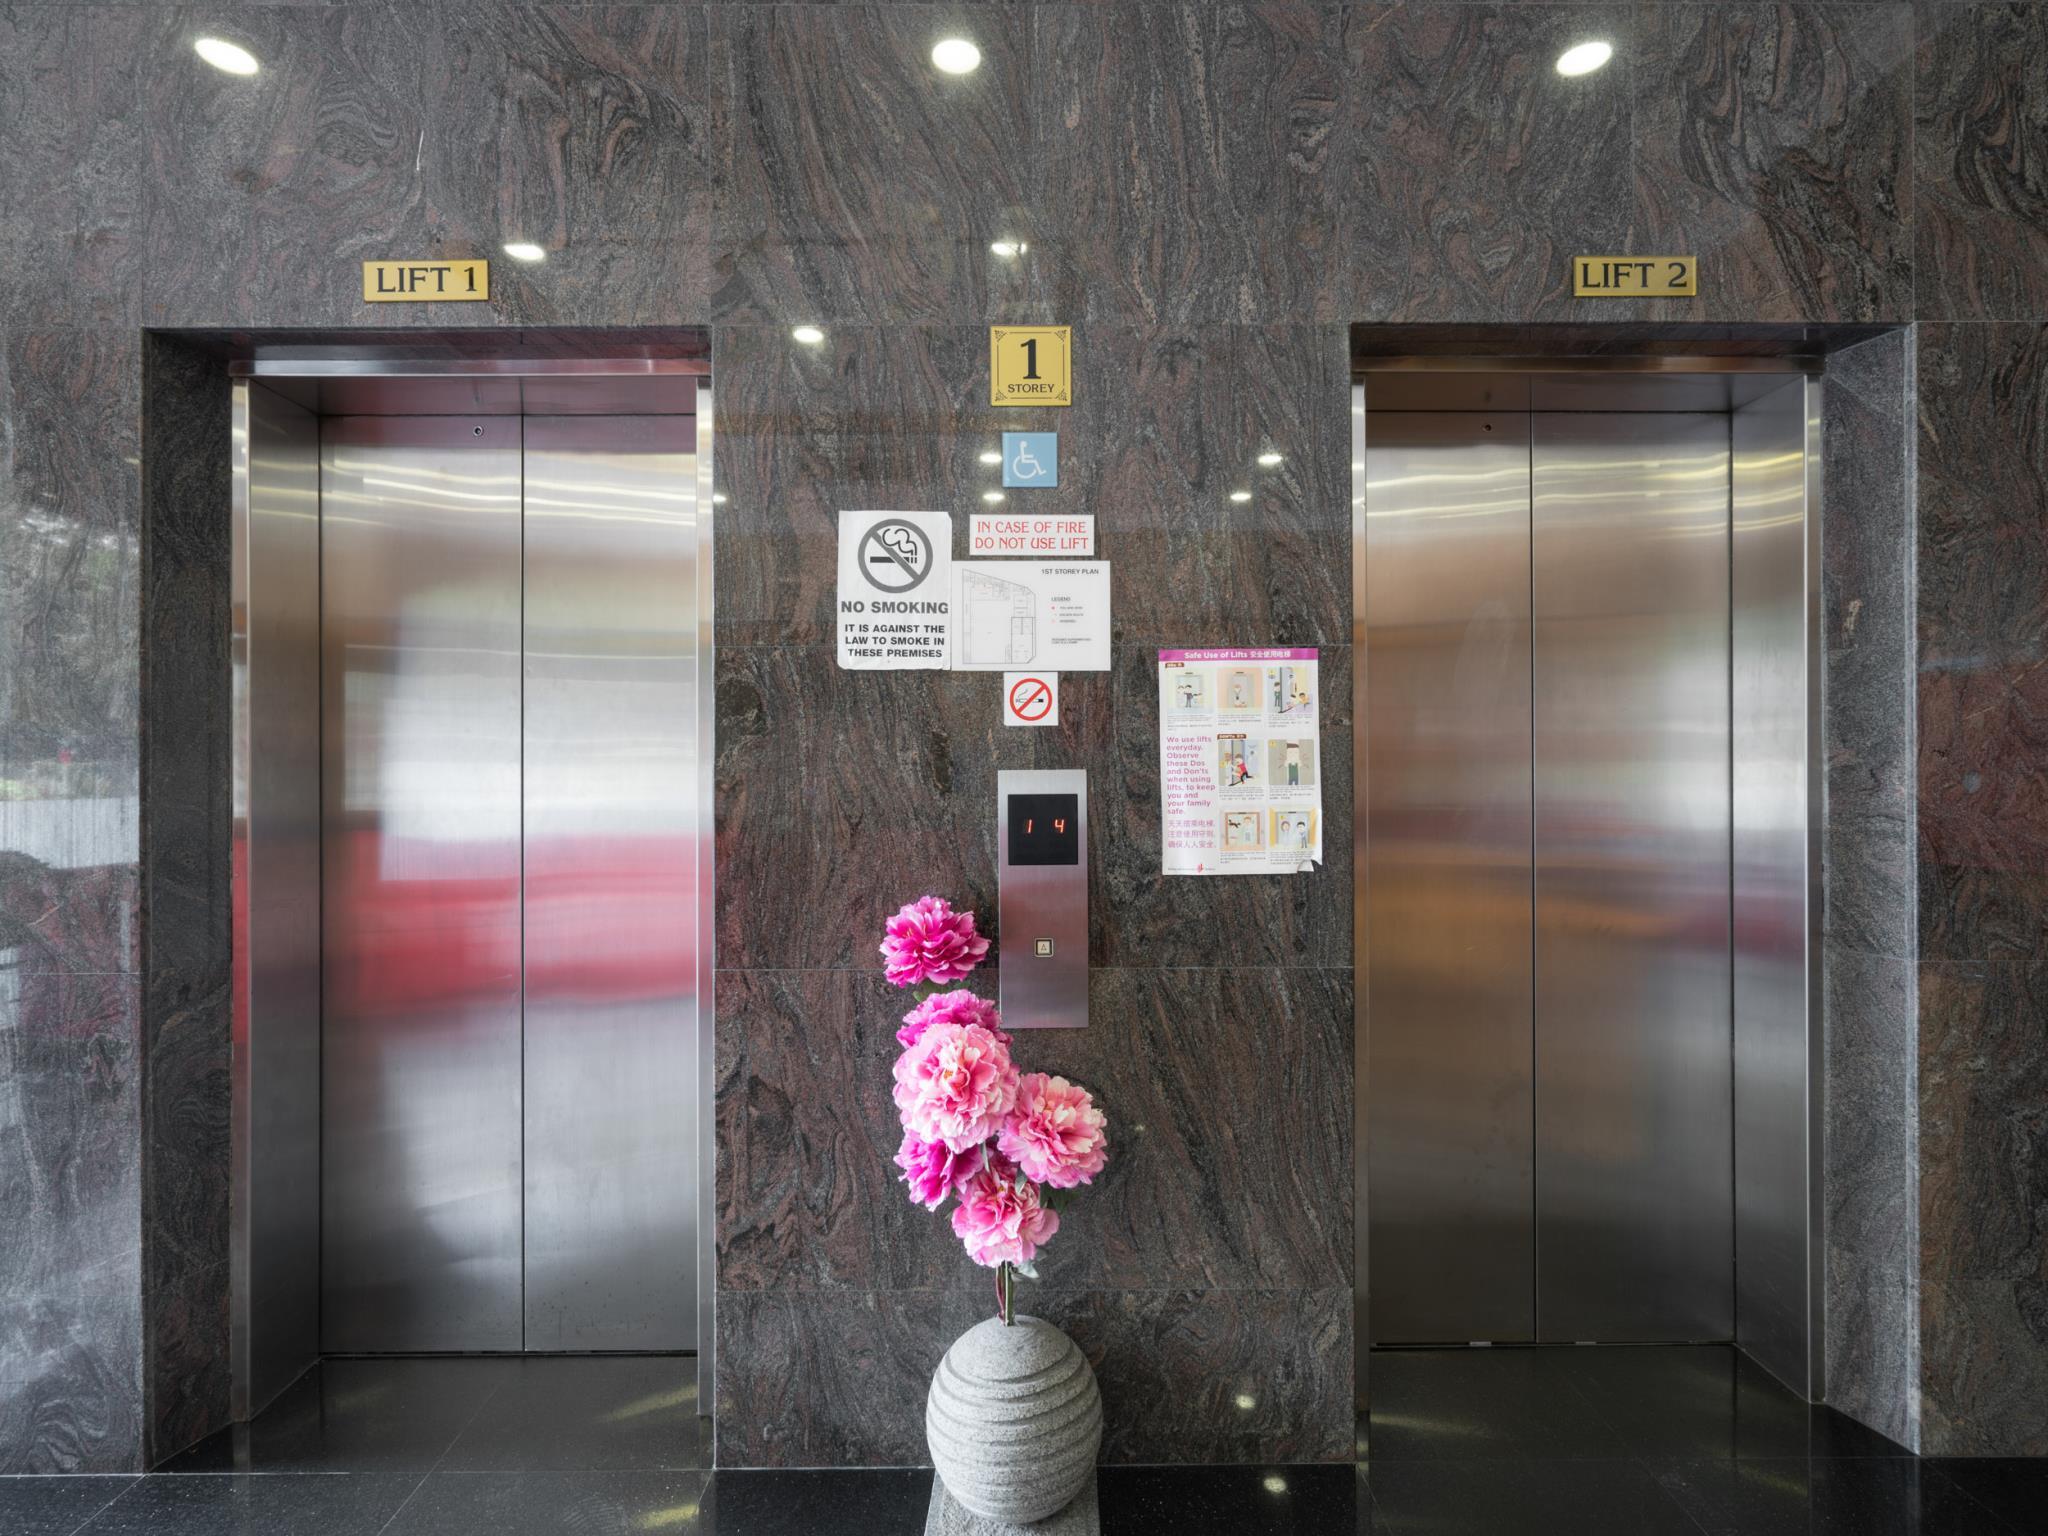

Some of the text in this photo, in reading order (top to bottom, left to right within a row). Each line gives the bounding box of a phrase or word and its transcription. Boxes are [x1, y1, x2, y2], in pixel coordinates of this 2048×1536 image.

[377, 266, 477, 293] LIFT 1
[1582, 262, 1687, 288] LIFT 2
[1020, 339, 1041, 380] 1
[1008, 384, 1055, 393] STOREY
[977, 521, 1087, 534] IN CASE OF FIRE
[975, 537, 1089, 549] DO NOT USE LIFT
[841, 601, 949, 614] NO SMOKING
[845, 624, 945, 633] IT IS AGAINST THE
[845, 636, 869, 645] LAW
[872, 637, 887, 645] TO
[890, 637, 930, 645] SMOKE
[848, 649, 943, 658] THESE PREMISES
[1026, 819, 1065, 834] 1 4
